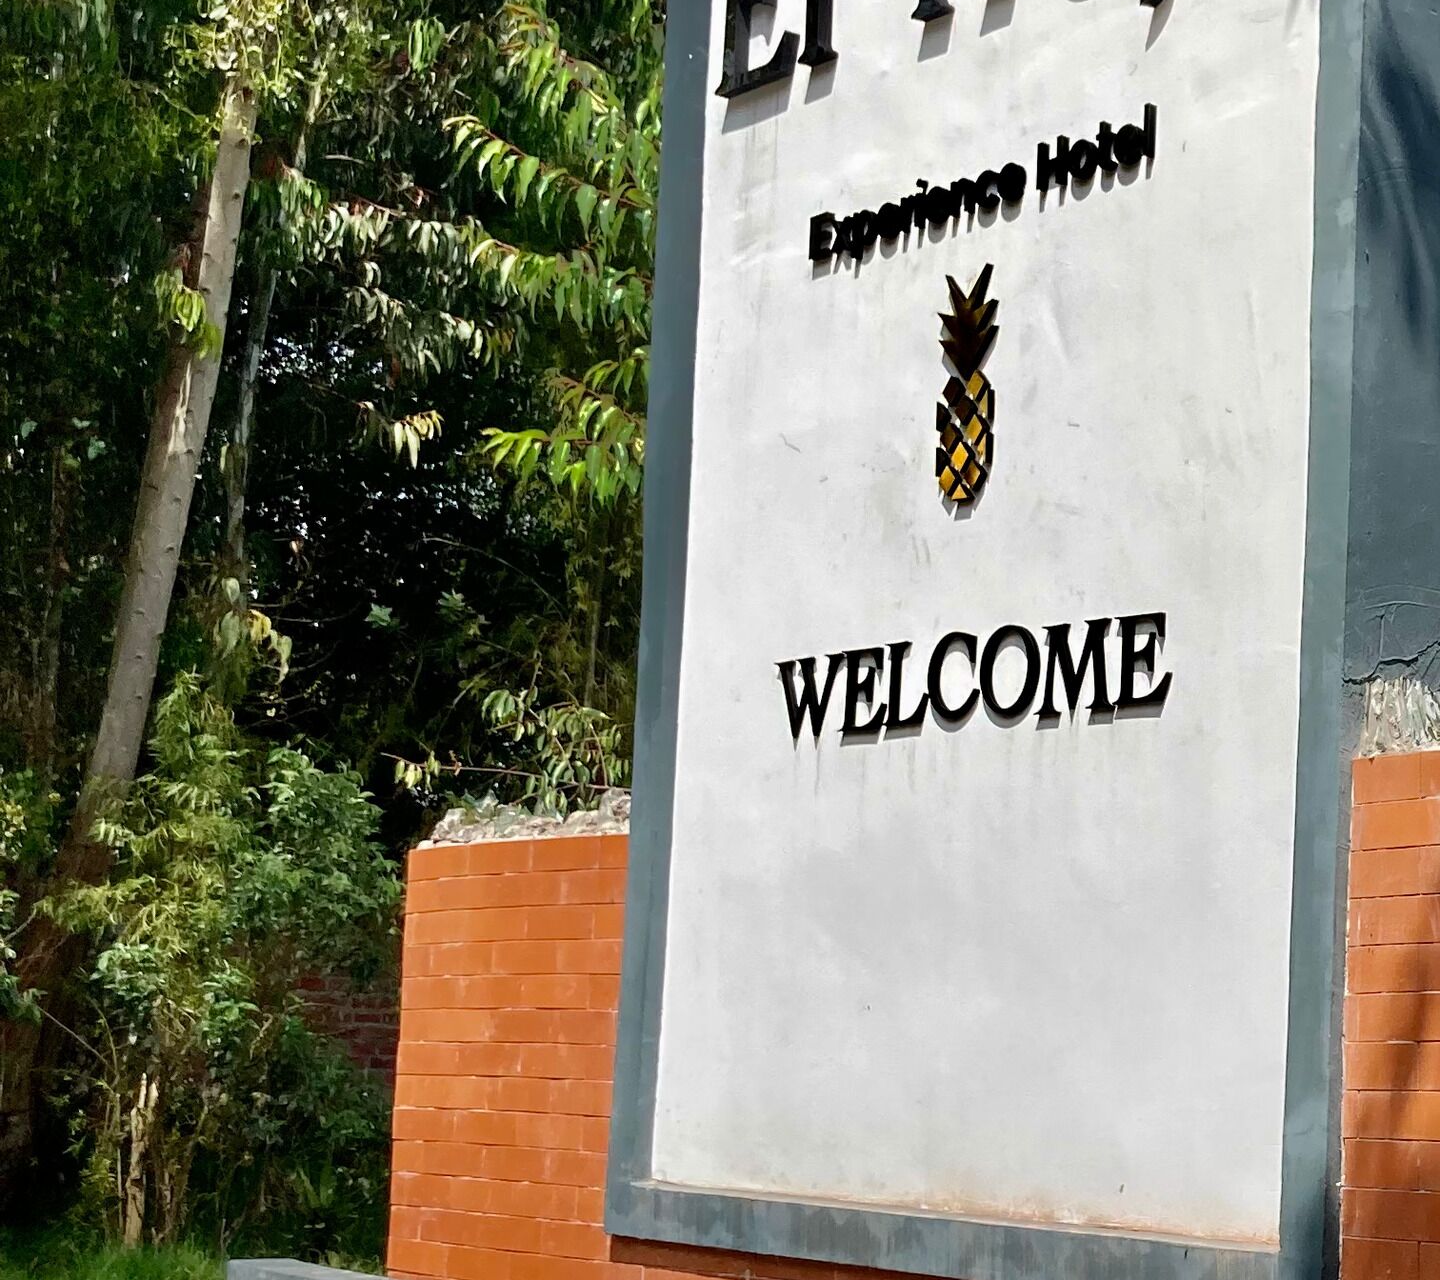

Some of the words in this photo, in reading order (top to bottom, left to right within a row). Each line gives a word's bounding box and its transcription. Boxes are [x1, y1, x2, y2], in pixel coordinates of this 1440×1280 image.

[809, 162, 1027, 263] Experience
[1036, 103, 1157, 193] Hotel
[774, 611, 1173, 742] WELCOME
